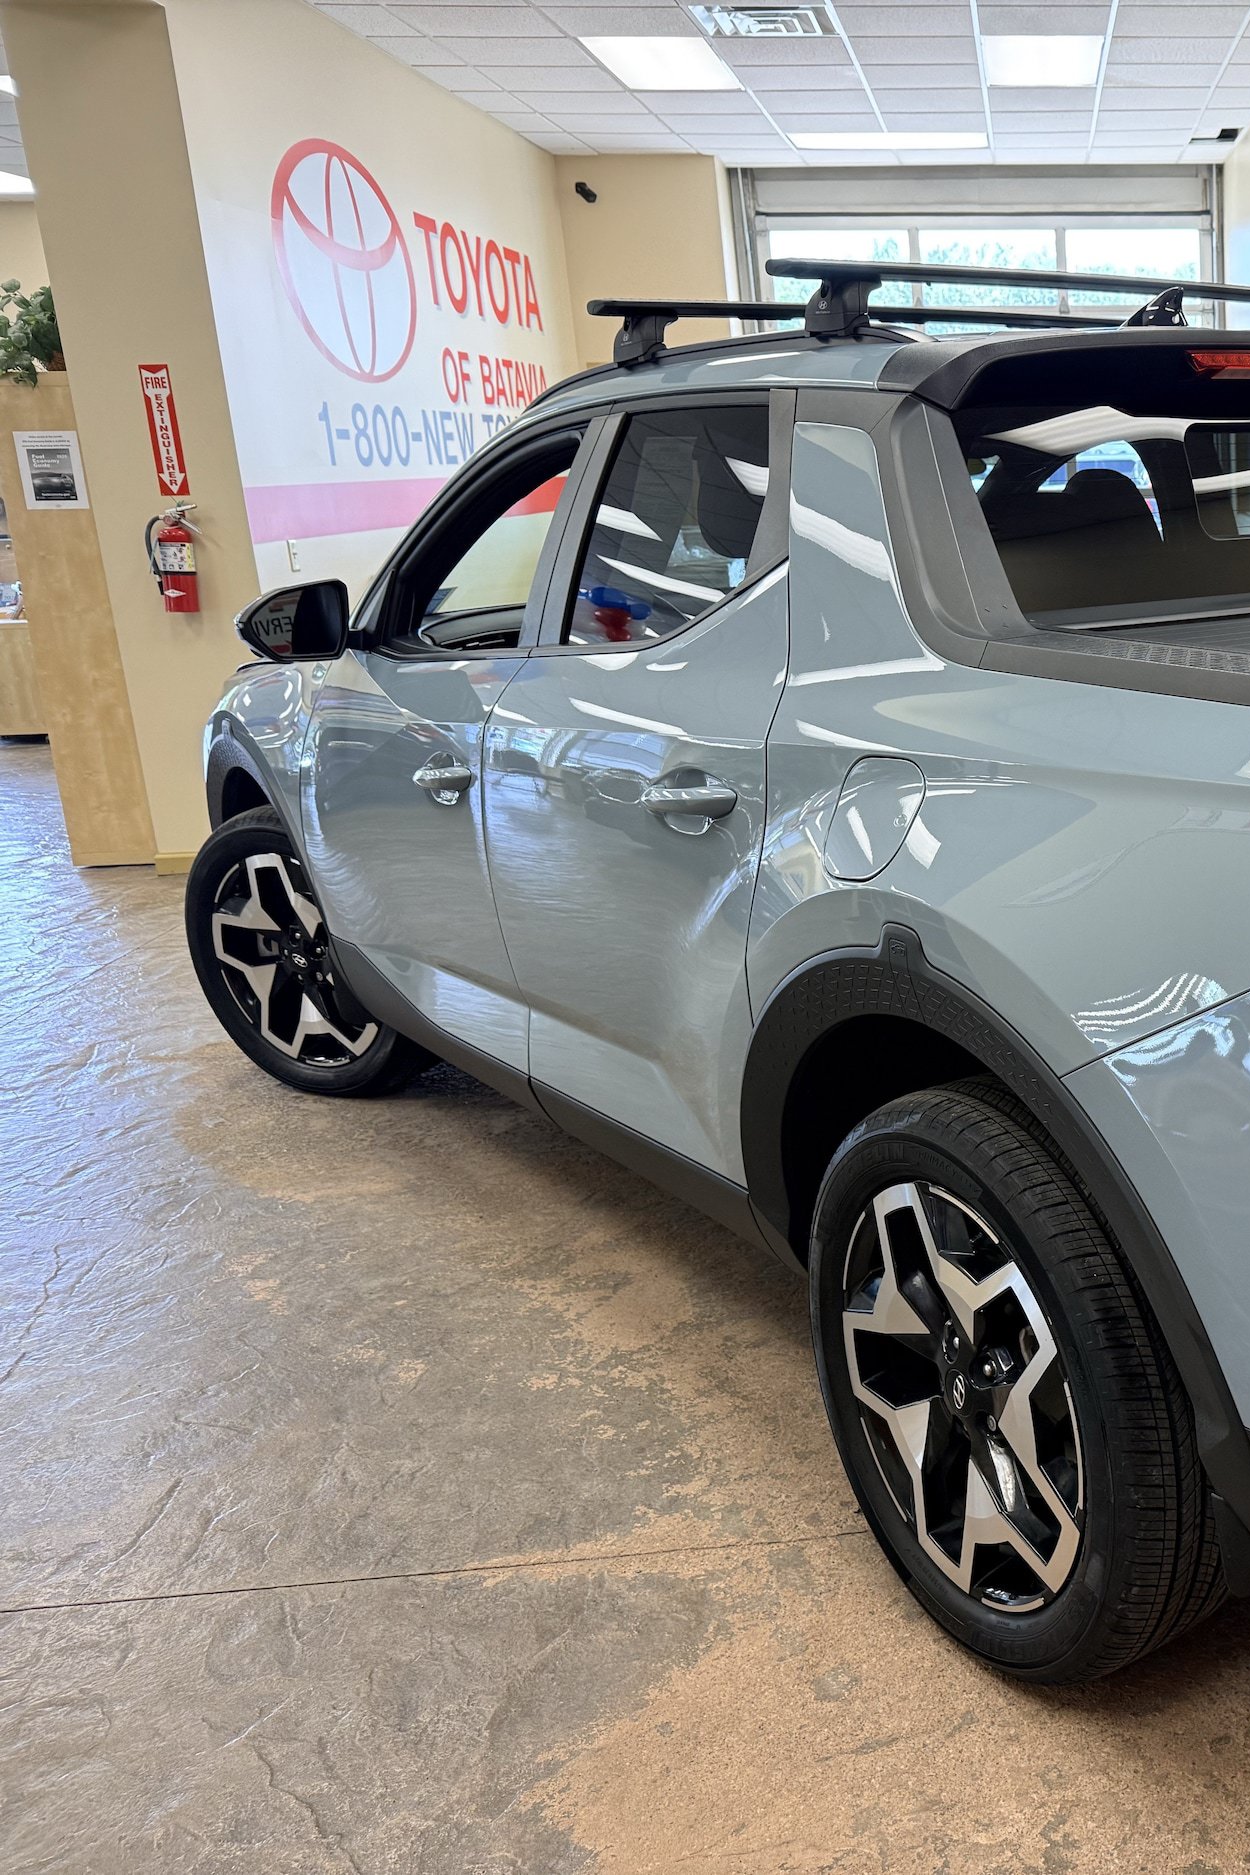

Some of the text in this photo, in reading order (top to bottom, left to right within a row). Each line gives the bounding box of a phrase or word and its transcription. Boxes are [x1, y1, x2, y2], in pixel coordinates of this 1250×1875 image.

[413, 211, 544, 332] TOYOTA
[144, 376, 168, 390] FIRE
[442, 347, 550, 409] OF BATAVIA
[155, 393, 179, 486] EXTINGUISHER
[318, 400, 475, 467] 1-800-NEW
